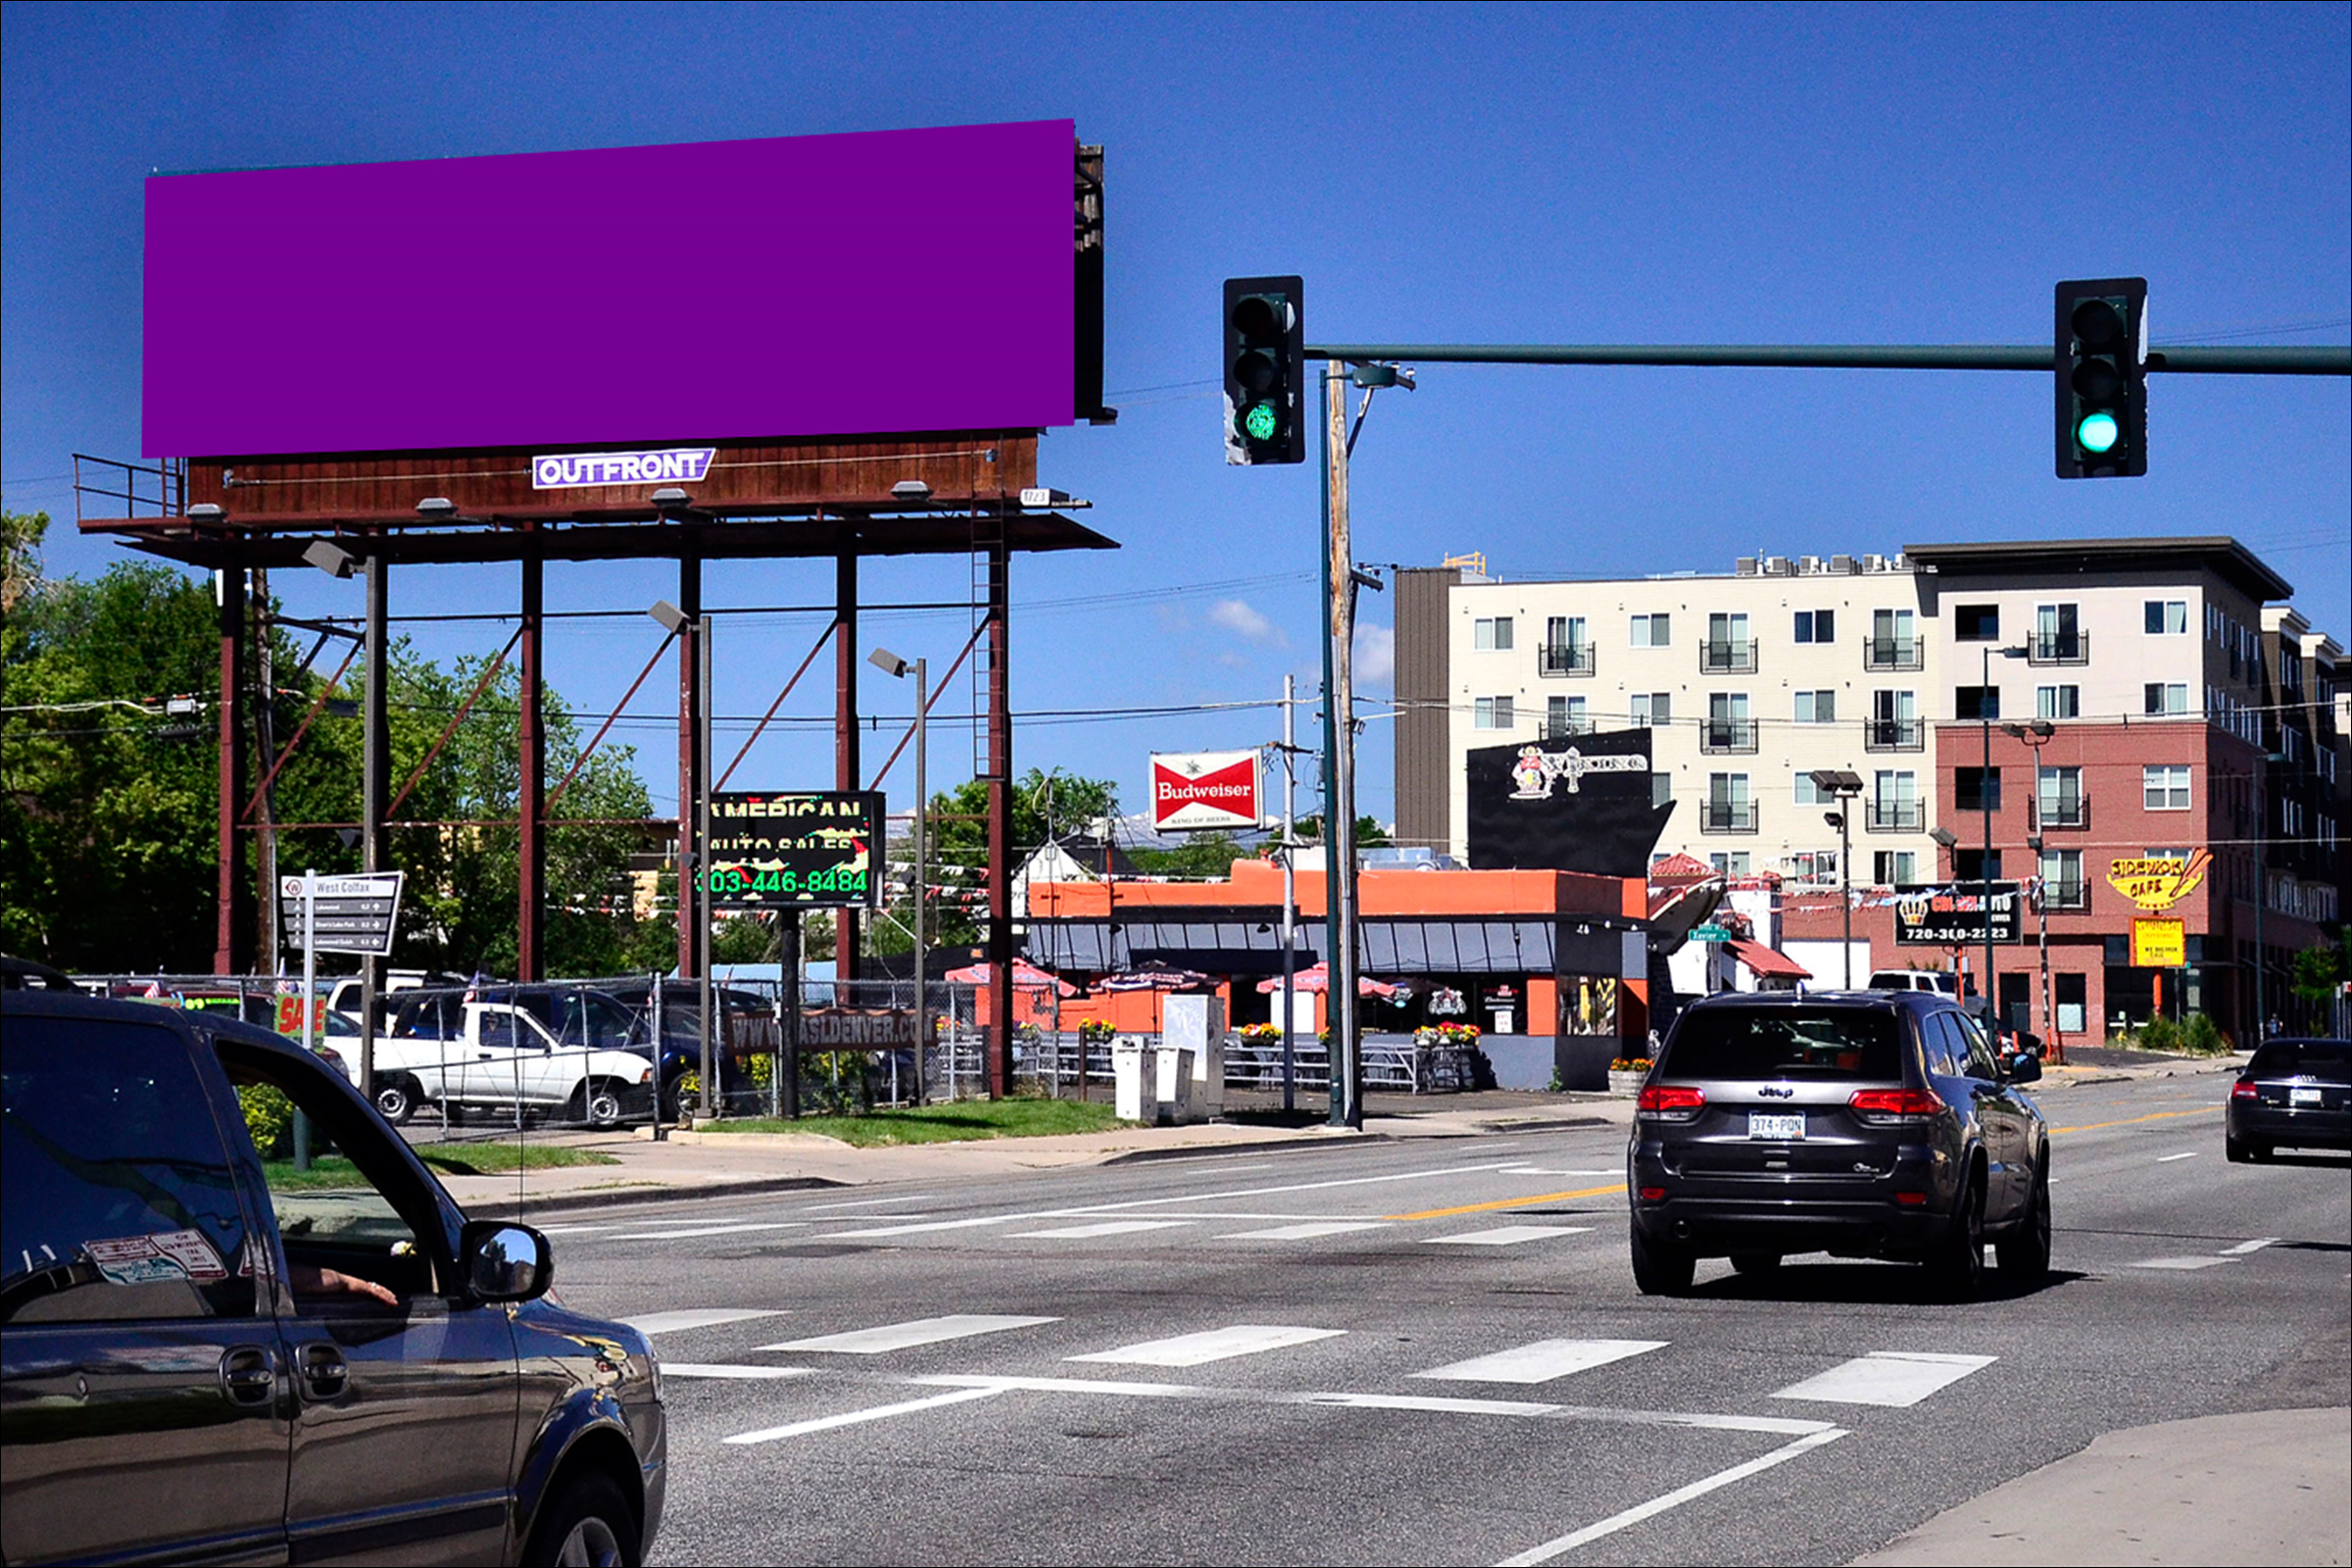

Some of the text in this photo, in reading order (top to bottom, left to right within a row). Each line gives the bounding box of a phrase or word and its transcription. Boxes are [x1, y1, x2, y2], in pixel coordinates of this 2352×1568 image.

[539, 452, 705, 484] OUTFRONT
[1023, 491, 1046, 502] 1723
[1157, 782, 1251, 800] Budweiser
[317, 881, 369, 893] West Colfax
[2130, 879, 2163, 898] CAFE
[278, 998, 324, 1033] SAE
[1758, 1085, 1794, 1099] Jeep
